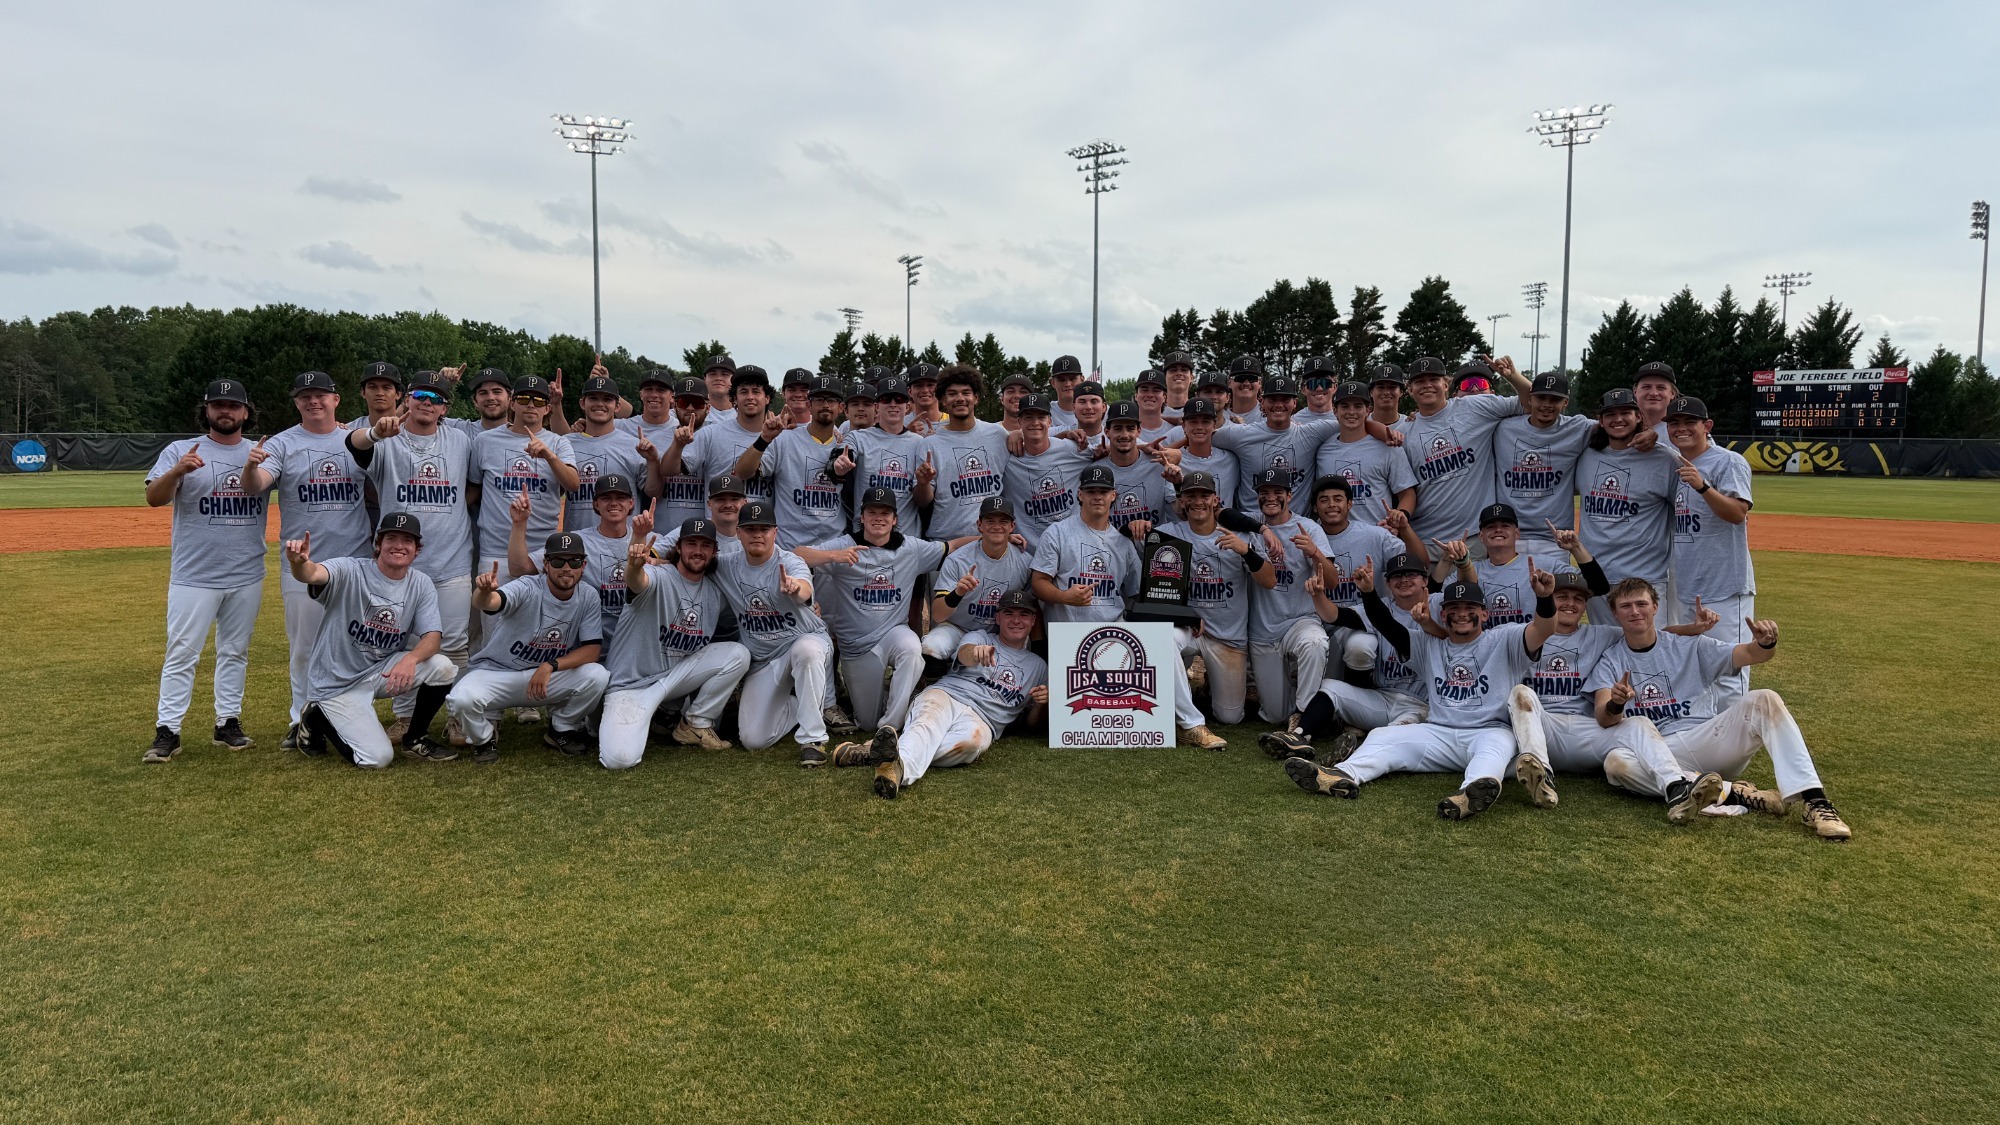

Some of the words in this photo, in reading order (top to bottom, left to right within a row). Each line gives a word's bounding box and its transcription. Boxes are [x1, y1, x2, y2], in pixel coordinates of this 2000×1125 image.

[376, 364, 386, 375] P
[1062, 360, 1069, 370] P
[1244, 359, 1251, 369] P
[1314, 359, 1322, 369] P
[1421, 360, 1429, 371] P
[797, 371, 804, 380] P
[874, 368, 881, 377] P
[920, 365, 929, 375] P
[1147, 371, 1156, 380] P
[1384, 367, 1392, 377] P
[304, 373, 314, 385] P
[429, 373, 438, 384] P
[528, 377, 537, 387] P
[822, 377, 829, 388] P
[1209, 373, 1217, 382] P
[1546, 377, 1555, 388] P
[1801, 373, 1847, 381] FEREBEE
[221, 382, 231, 394] P
[596, 378, 605, 388] P
[686, 380, 694, 391] P
[888, 379, 896, 389] P
[1276, 379, 1284, 390] P
[1348, 383, 1357, 394] P
[857, 385, 865, 394] P
[1028, 395, 1037, 406] P
[1766, 393, 1775, 402] 13
[1836, 392, 1843, 401] 2
[1872, 392, 1879, 401] 2
[1120, 404, 1128, 415] P
[1196, 401, 1204, 411] P
[1677, 399, 1687, 411] P
[16, 454, 46, 464] NCAA
[1419, 448, 1475, 481] CHAMPS
[1092, 469, 1101, 480] P
[1194, 473, 1202, 484] P
[1266, 470, 1275, 482] P
[1504, 470, 1563, 489] CHAMPS
[494, 477, 547, 493] CHAMPS
[609, 476, 618, 487] P
[721, 476, 730, 488] P
[869, 474, 914, 493] CHAMPS
[950, 474, 1001, 498] CHAMPS
[297, 483, 359, 502] CHAMPS
[397, 484, 458, 503] CHAMPS
[876, 489, 884, 499] P
[200, 497, 262, 516] CHAMPS
[994, 498, 1002, 508] P
[1024, 489, 1074, 517] CHAMPS
[1584, 495, 1640, 516] CHAMPS
[752, 505, 761, 518] P
[1493, 505, 1502, 516] P
[396, 515, 406, 527] P
[695, 521, 704, 531] P
[562, 535, 571, 548] P
[1398, 556, 1406, 566] P
[1569, 574, 1578, 583] P
[853, 588, 901, 603] CHAMPS
[1147, 592, 1180, 600] CHAMPIONS
[1456, 585, 1465, 598] P
[1013, 593, 1022, 603] P
[738, 612, 796, 632] CHAMPS
[348, 619, 407, 649] CHAMPS
[659, 624, 710, 652] CHAMPS
[1081, 633, 1101, 669] ATHLETIC
[1106, 631, 1142, 668] CONFERENCE
[1073, 673, 1099, 689] USA
[1106, 673, 1149, 689] SOUTH
[1435, 674, 1489, 700] CHAMPS
[1092, 715, 1134, 728] 2026
[1062, 731, 1164, 745] CHAMPIONS
